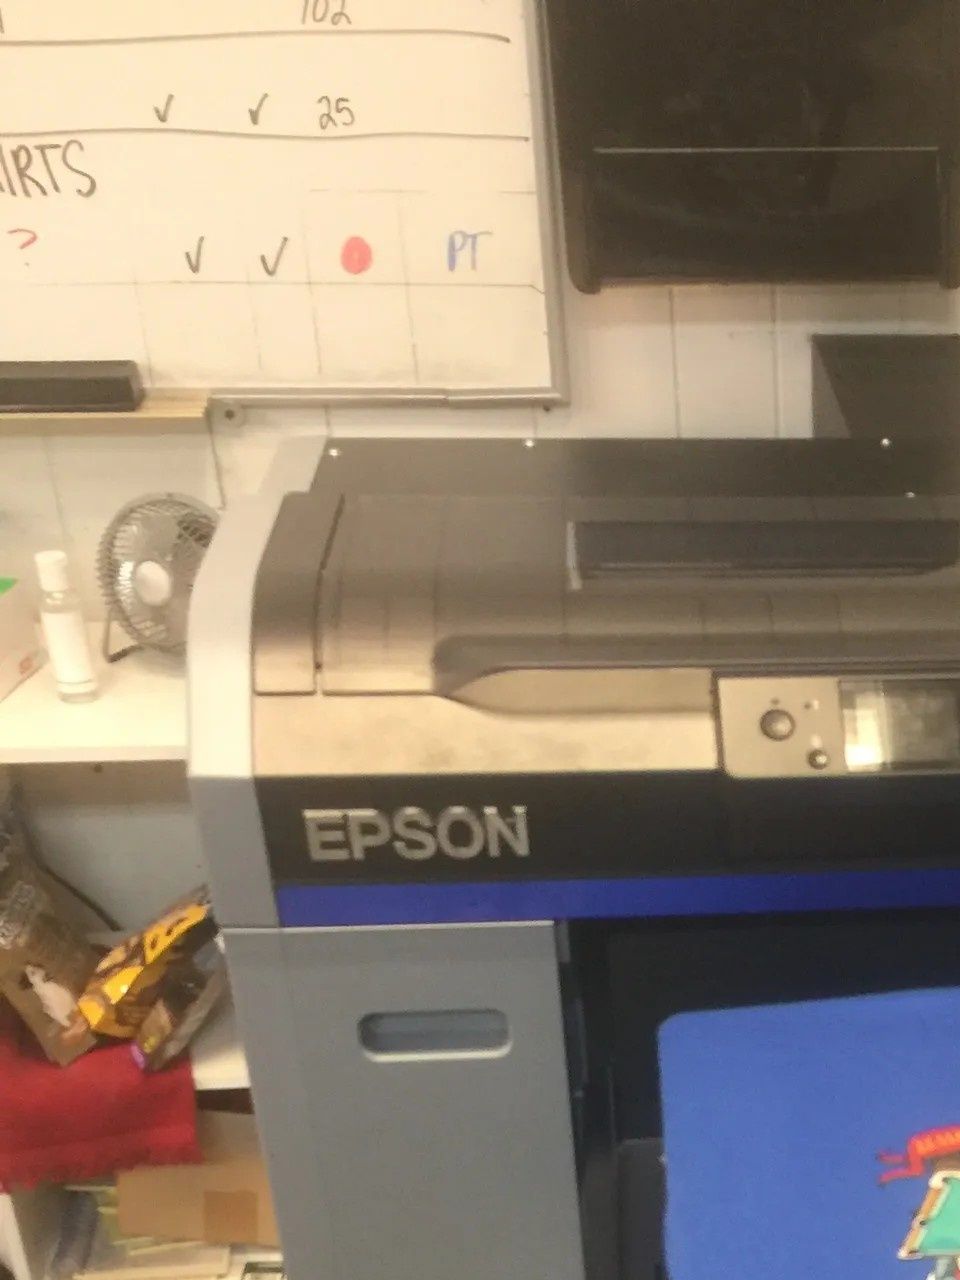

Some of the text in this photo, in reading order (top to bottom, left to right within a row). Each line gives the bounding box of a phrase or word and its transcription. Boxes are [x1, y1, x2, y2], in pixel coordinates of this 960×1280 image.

[316, 95, 356, 129] 25
[0, 139, 97, 198] IRTS
[446, 230, 493, 272] PT
[302, 805, 531, 861] EPSON
